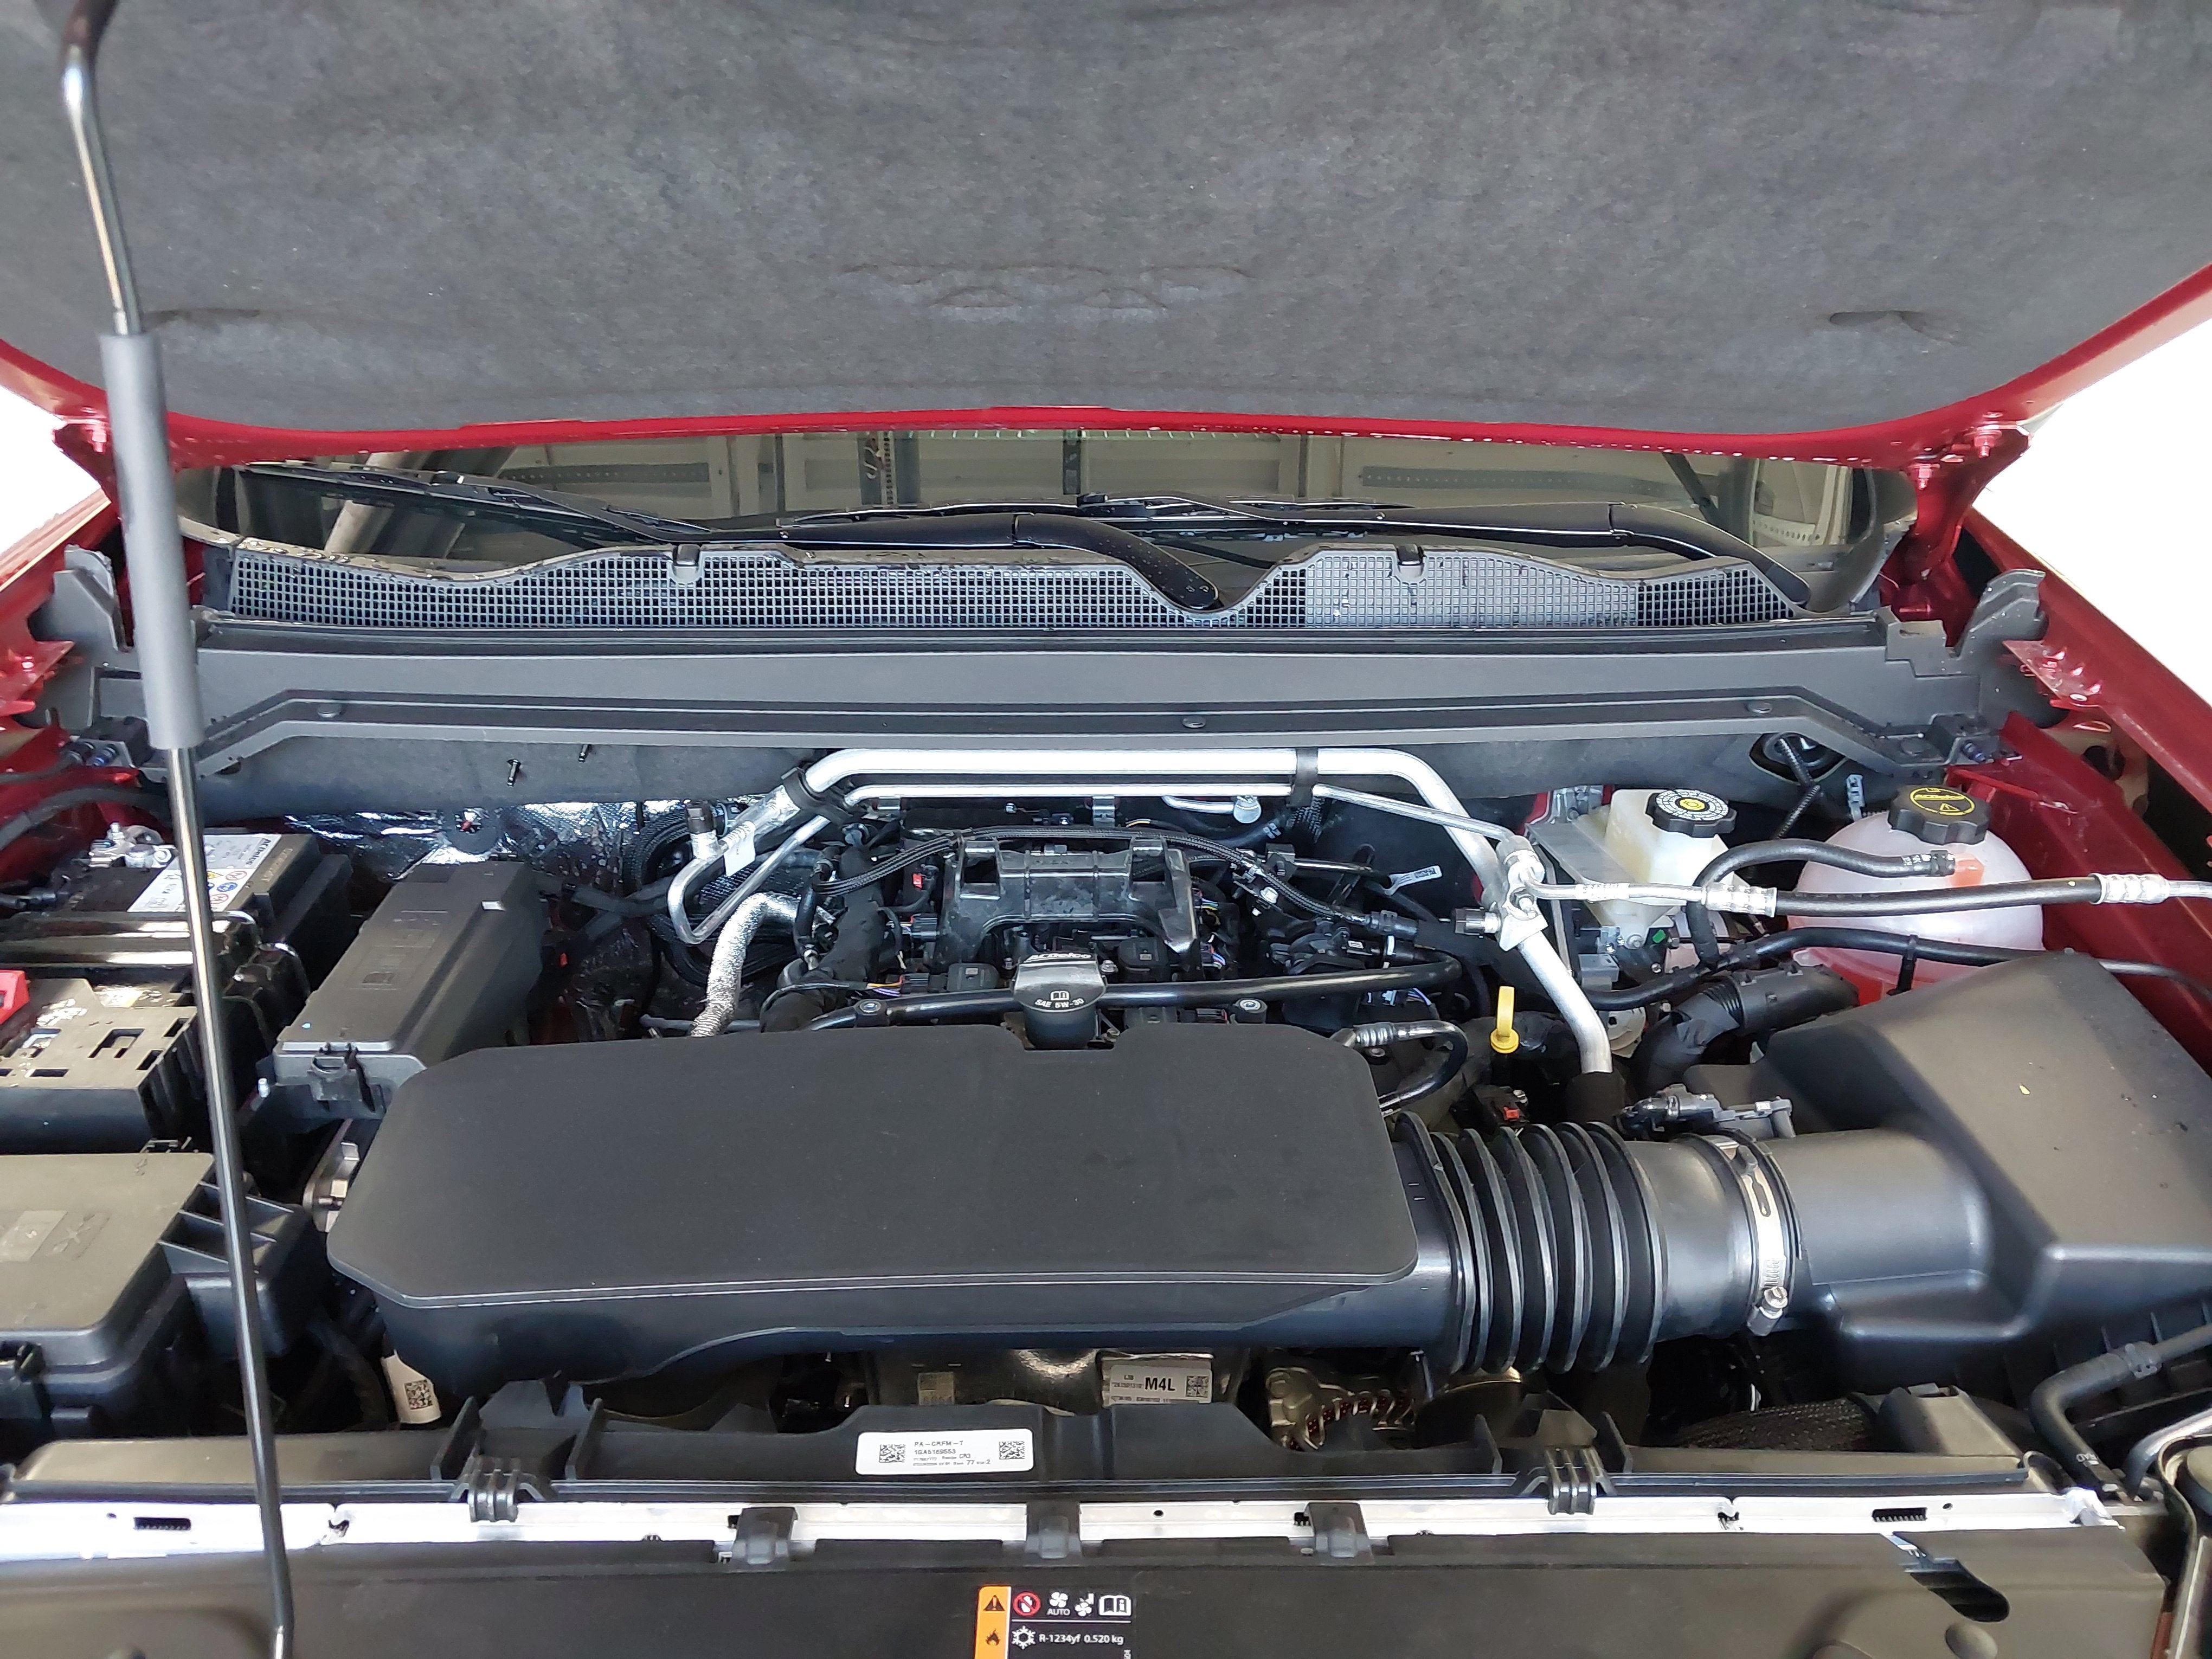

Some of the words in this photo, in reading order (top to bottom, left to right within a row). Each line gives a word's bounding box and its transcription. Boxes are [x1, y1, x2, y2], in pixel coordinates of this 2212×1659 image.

[246, 839, 272, 865] ACDelco
[1023, 953, 1092, 963] ACDelco
[1034, 999, 1052, 1008] SAE
[1054, 998, 1085, 1008] 5W-30
[1145, 1377, 1175, 1391] M4L
[1047, 1608, 1071, 1616] AUTO
[1039, 1633, 1081, 1645] R-1234yf
[1084, 1634, 1110, 1644] 0.520
[1112, 1634, 1124, 1645] kg
